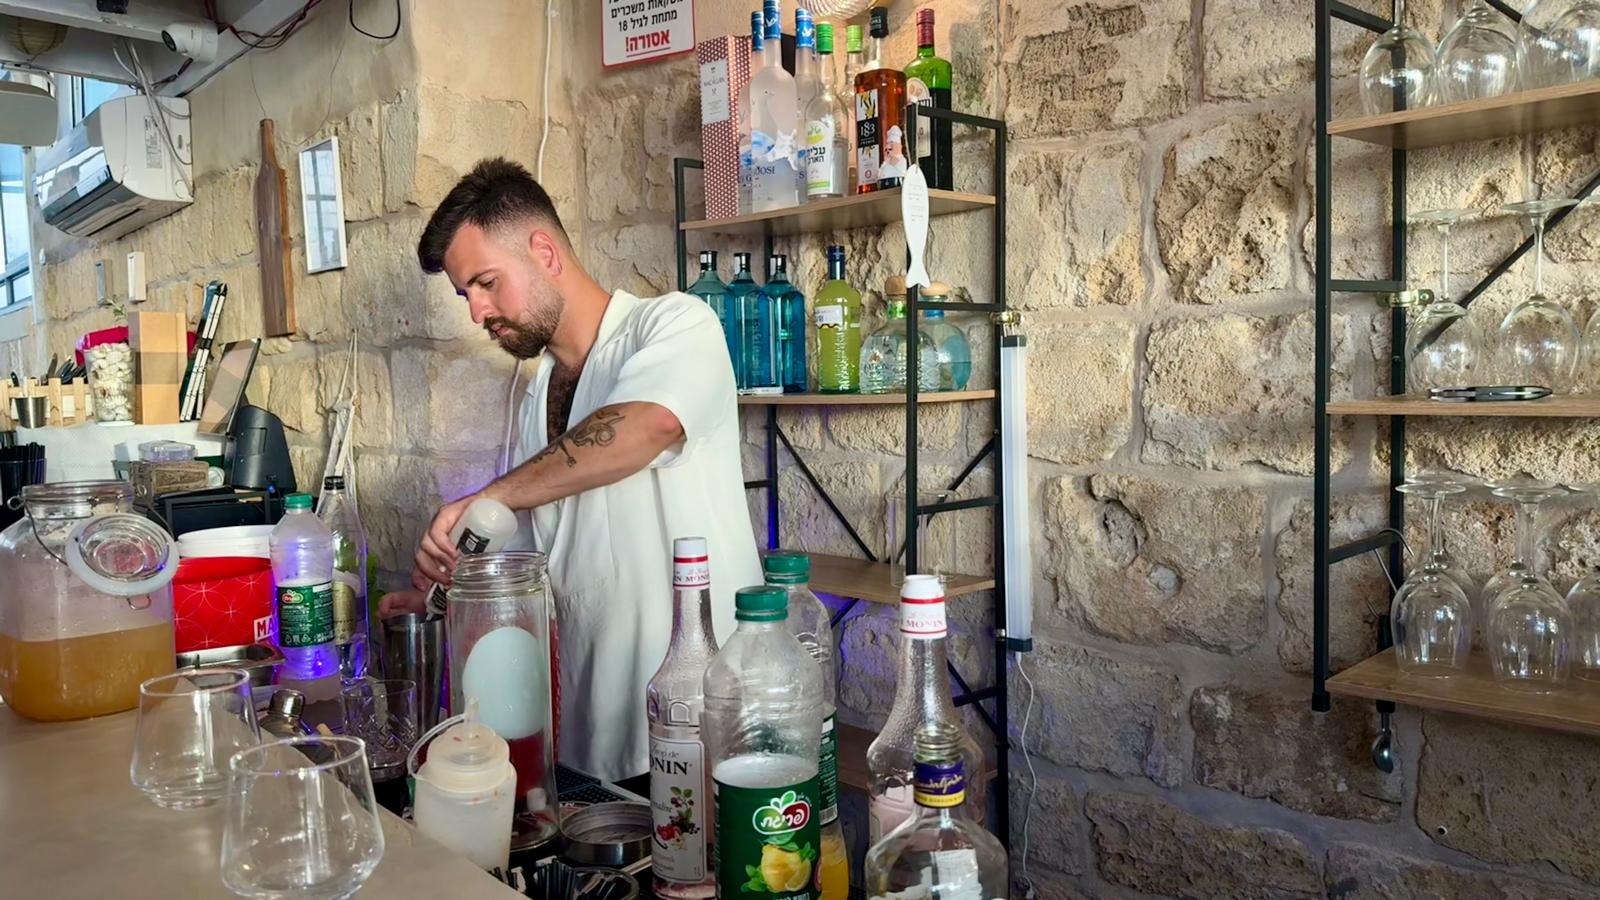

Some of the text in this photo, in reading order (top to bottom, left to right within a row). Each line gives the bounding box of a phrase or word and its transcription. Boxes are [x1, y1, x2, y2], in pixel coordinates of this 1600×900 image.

[611, 0, 684, 19] קאות משכרים
[619, 9, 678, 32] מתחת לגיל 18
[625, 29, 670, 52] אסורה!
[761, 808, 805, 829] פריגת
